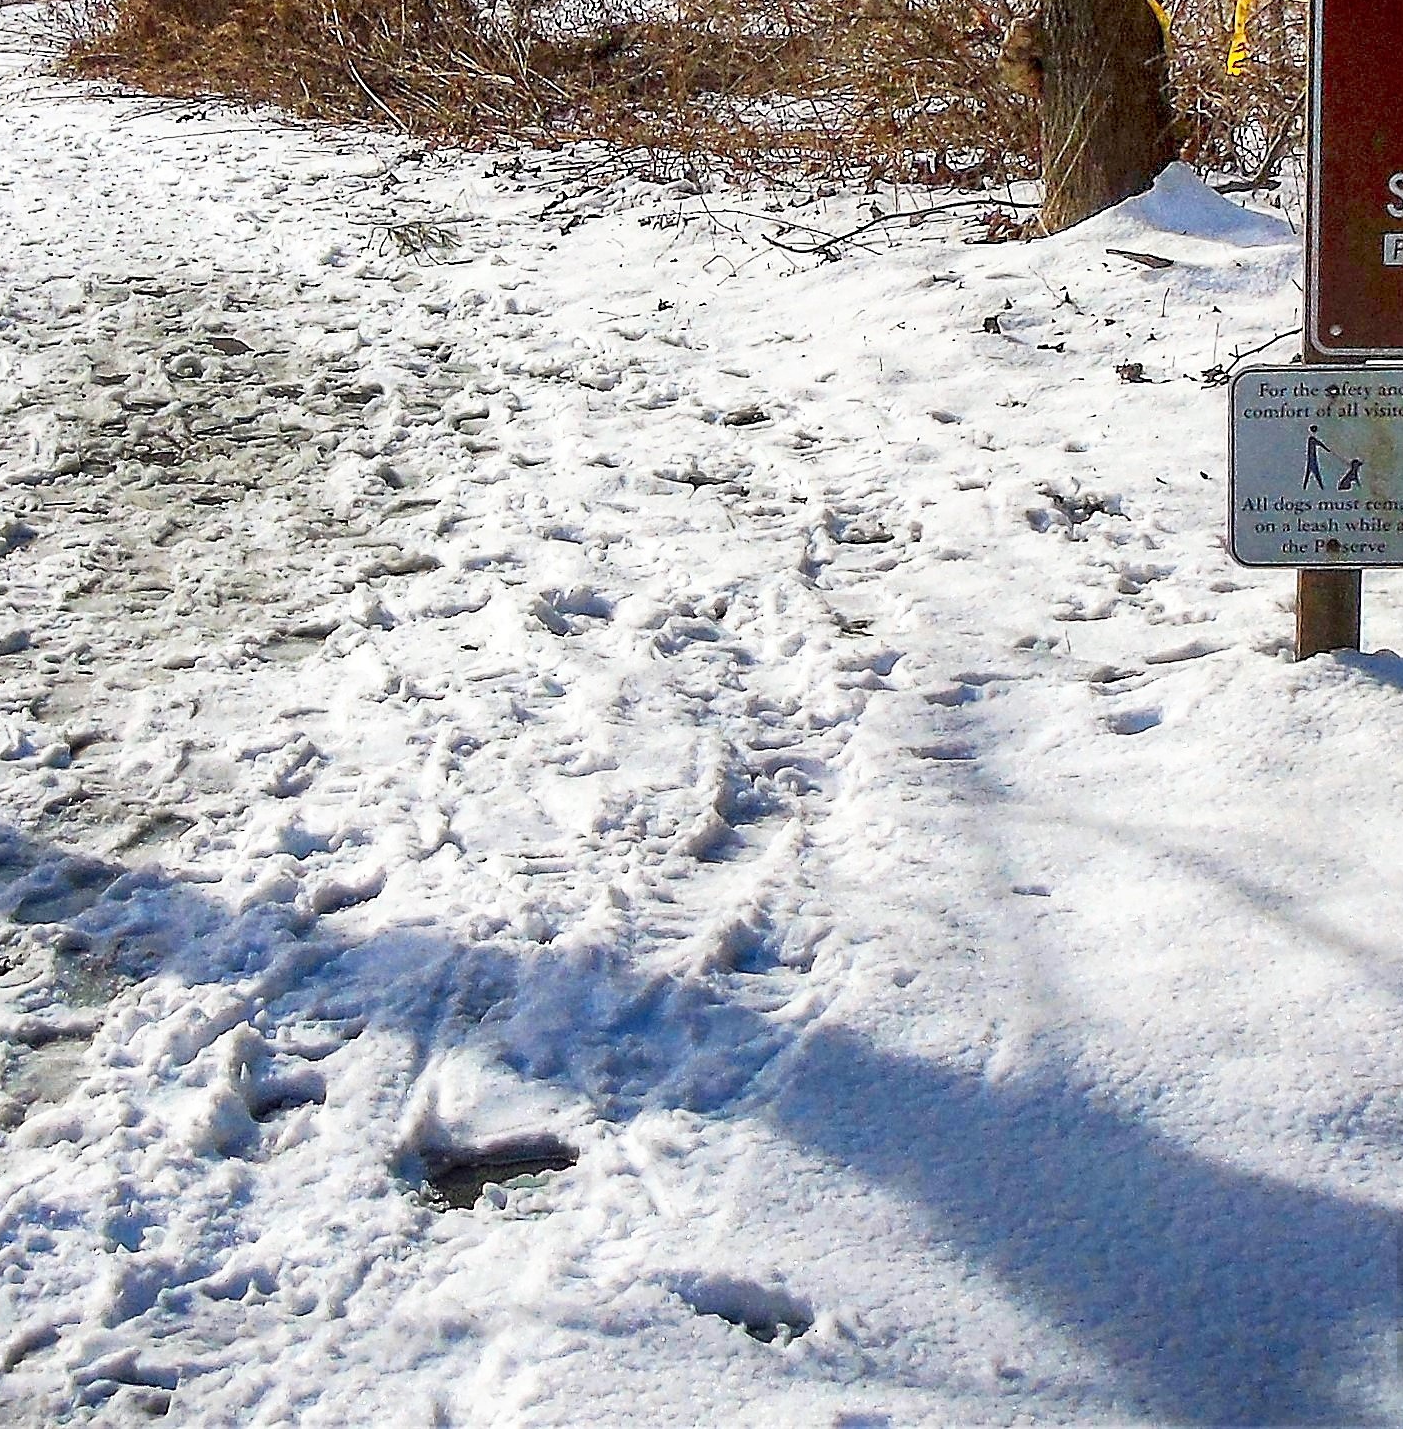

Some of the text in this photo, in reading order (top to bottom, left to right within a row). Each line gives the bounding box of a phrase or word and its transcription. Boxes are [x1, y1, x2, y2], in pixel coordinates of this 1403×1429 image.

[1259, 383, 1288, 397] For
[1294, 382, 1319, 396] the
[1244, 403, 1310, 419] comfort
[1316, 402, 1333, 418] of
[1338, 403, 1359, 417] all
[1242, 497, 1268, 512] All
[1274, 497, 1313, 514] dogs
[1318, 499, 1359, 511] must
[1255, 522, 1276, 534] on
[1283, 521, 1292, 532] a
[1298, 518, 1340, 533] leash
[1346, 517, 1392, 533] while
[1282, 538, 1387, 554] the Pserve
